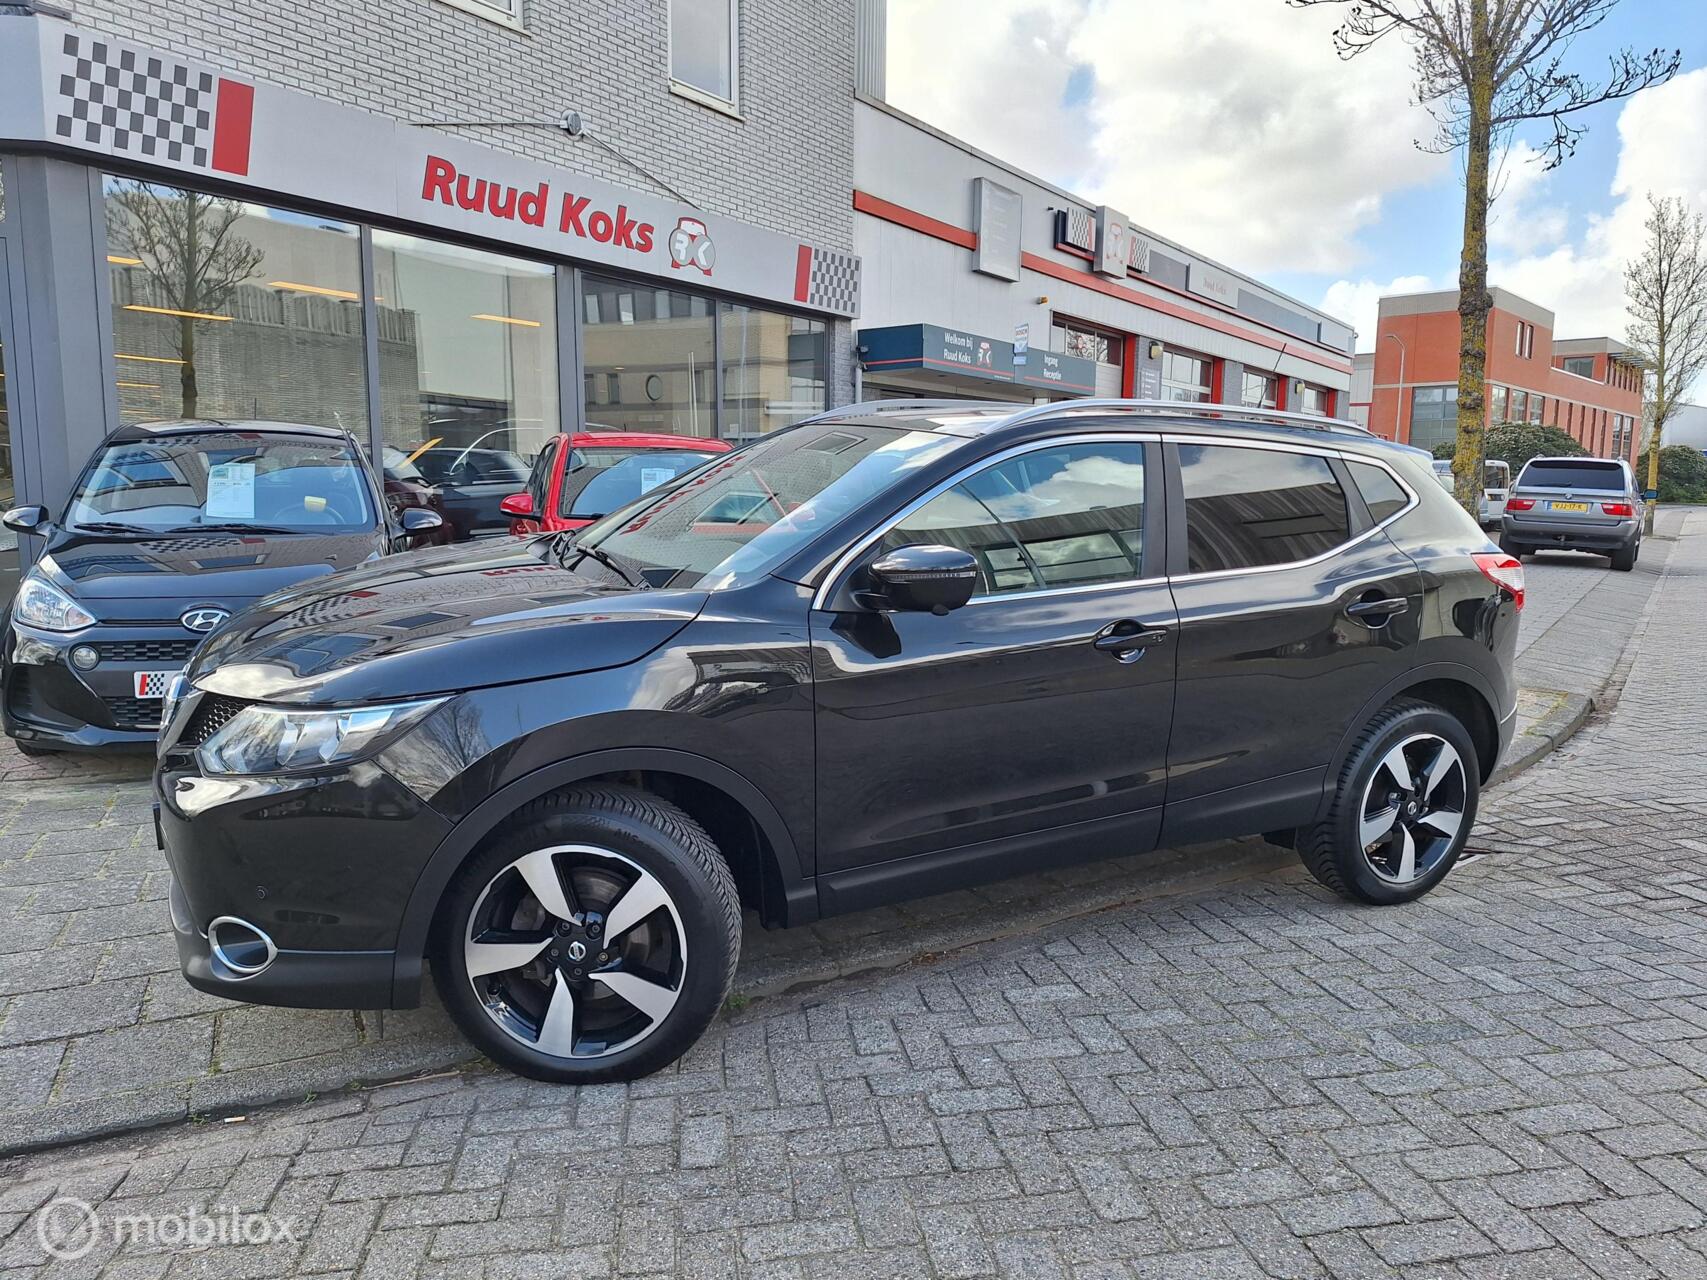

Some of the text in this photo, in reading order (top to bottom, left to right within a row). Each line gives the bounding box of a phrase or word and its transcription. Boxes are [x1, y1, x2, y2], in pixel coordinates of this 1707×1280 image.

[422, 154, 655, 253] Ruud Koks
[944, 332, 966, 347] Welkom
[943, 348, 972, 364] Ruud Koks
[1043, 368, 1062, 381] Receptie
